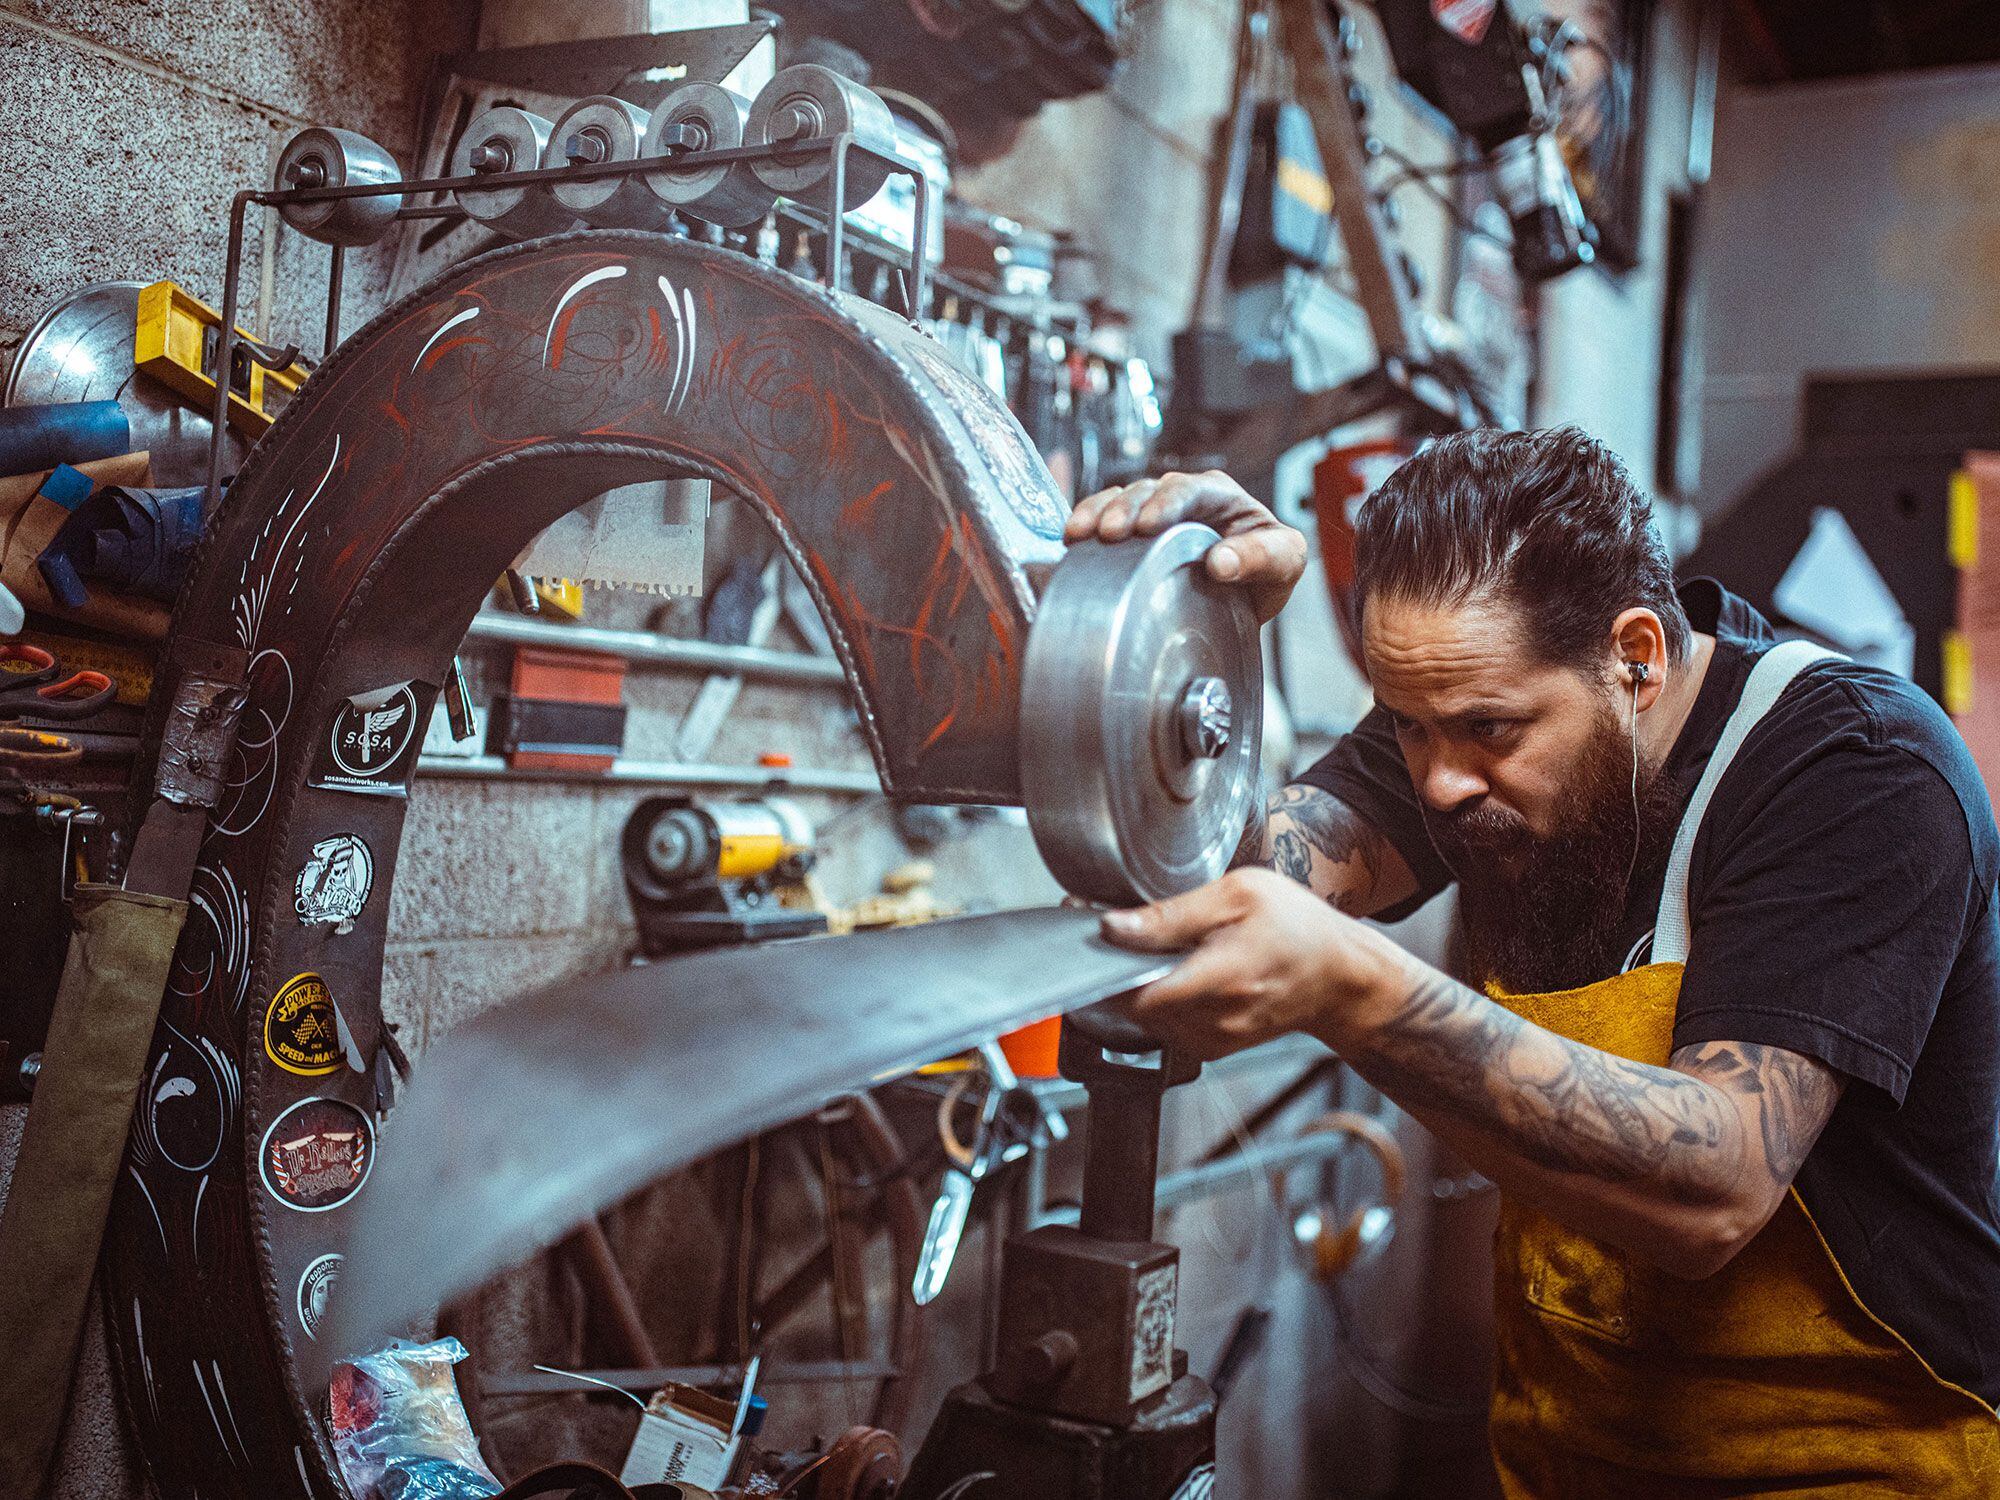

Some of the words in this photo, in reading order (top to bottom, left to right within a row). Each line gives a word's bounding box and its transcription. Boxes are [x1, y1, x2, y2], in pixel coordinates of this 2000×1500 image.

[345, 731, 392, 749] SOSA
[324, 775, 389, 787] sosametalworks.com
[278, 1042, 305, 1062] SPEED
